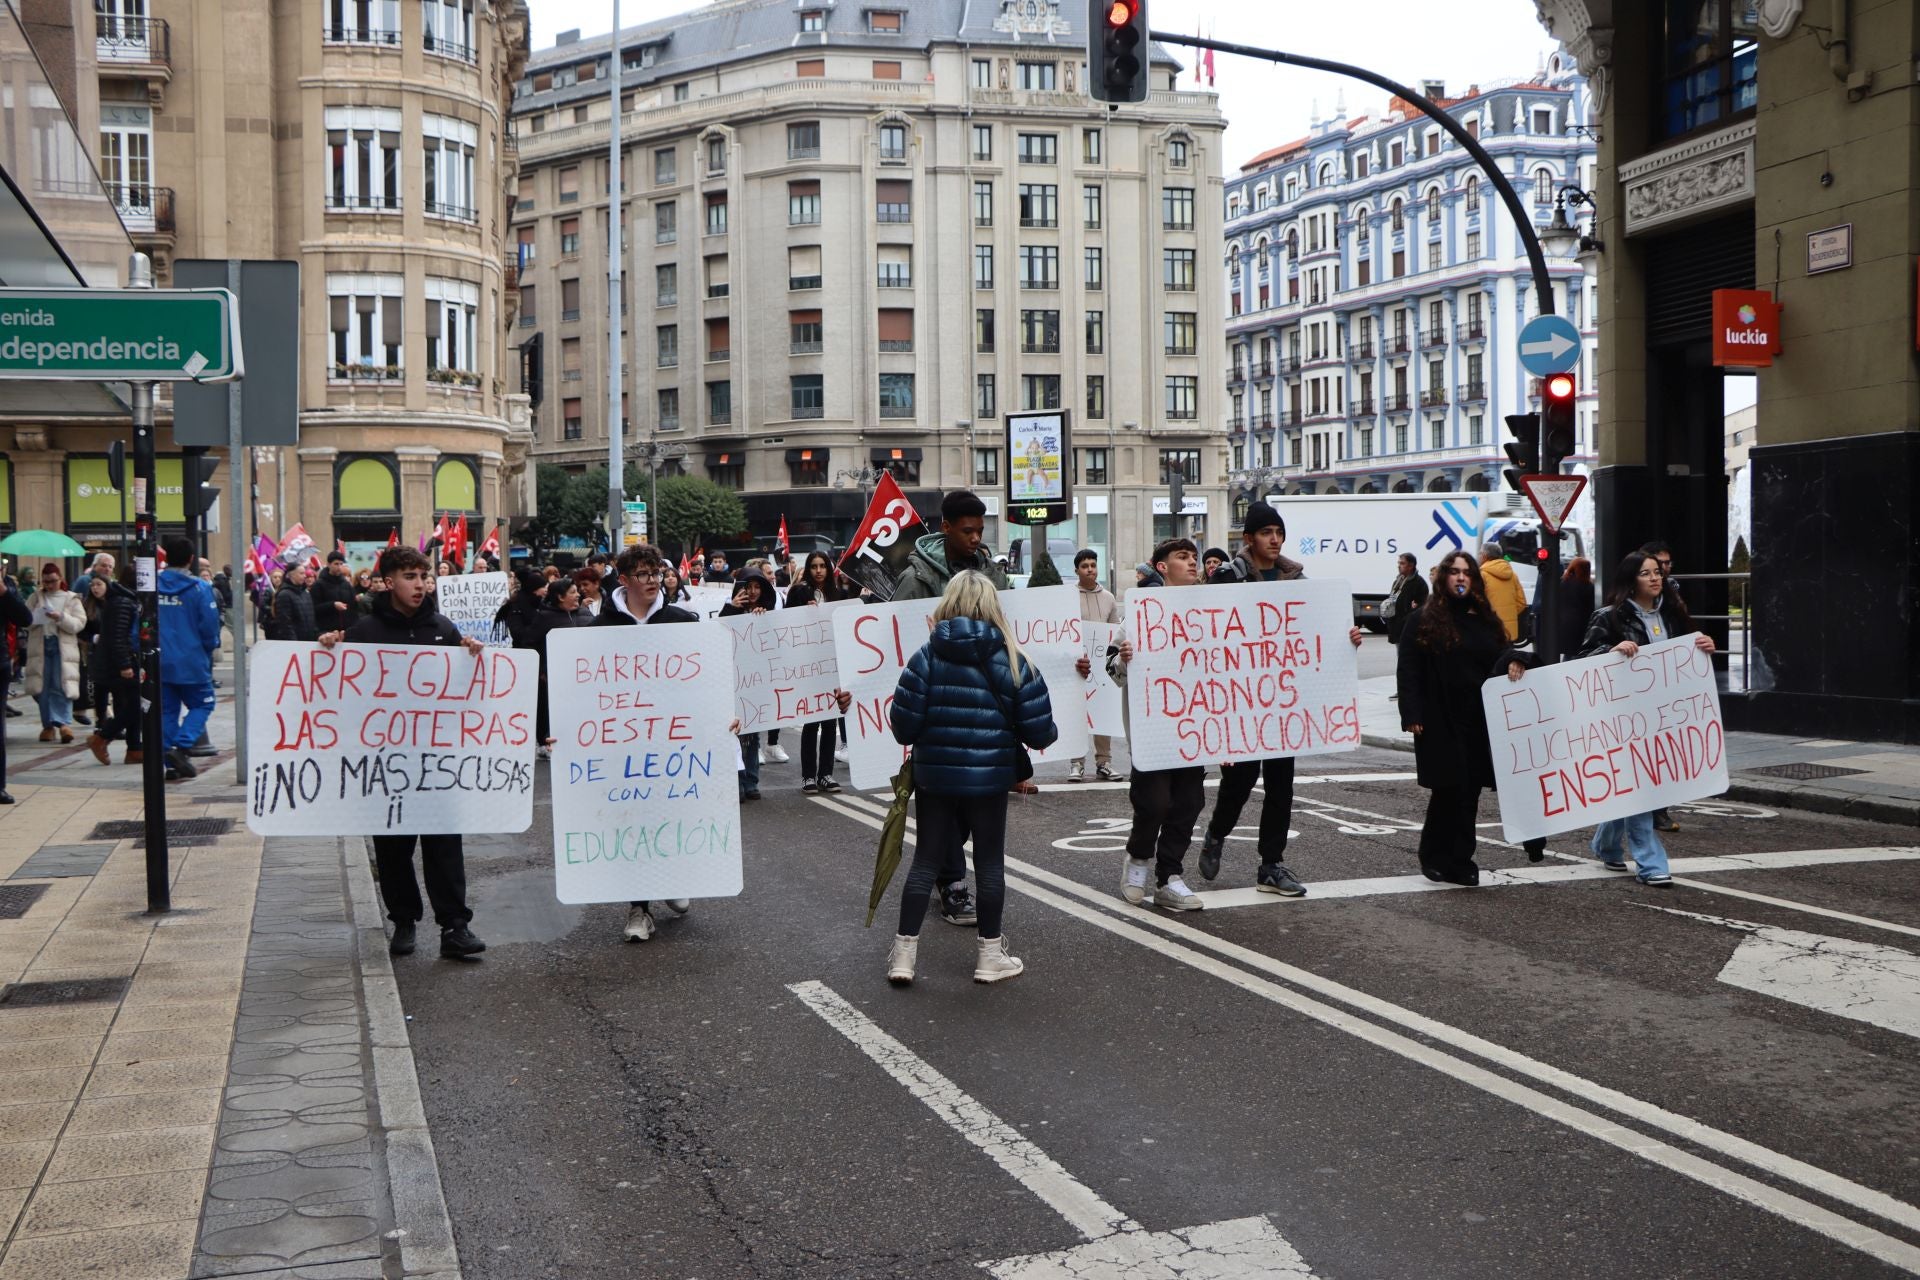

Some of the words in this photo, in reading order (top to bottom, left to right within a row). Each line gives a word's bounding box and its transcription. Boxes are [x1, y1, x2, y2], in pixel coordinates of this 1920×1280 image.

[1726, 328, 1768, 345] luckia
[855, 498, 913, 564] CGT
[1319, 538, 1398, 553] FADIS
[442, 584, 456, 596] EN
[457, 581, 471, 594] LA
[474, 581, 507, 595] EDUCA
[1014, 618, 1082, 645] UCHAS
[1134, 597, 1246, 652] ¡BASTA
[1257, 601, 1307, 637] DE
[276, 650, 517, 705] ARREGLAD
[575, 652, 701, 684] BARRIOS
[1501, 687, 1556, 731] EL
[1565, 645, 1710, 713] MAESTRO
[597, 690, 654, 711] DEL
[740, 697, 771, 729] DE
[274, 709, 339, 751] LAS
[360, 708, 529, 748] GOTERAS
[577, 716, 693, 747] OESTE
[1510, 711, 1647, 775] LUCHANDO
[1657, 692, 1717, 731] ESTA
[340, 747, 410, 799] MÁS
[416, 753, 531, 794] ESCUSAS
[570, 758, 608, 785] DE
[623, 745, 713, 779] LEÓN
[1538, 719, 1723, 817] ENSEÑANDO
[607, 786, 652, 802] CON
[667, 782, 700, 800] LA
[565, 818, 732, 864] EDUCACIÓN
